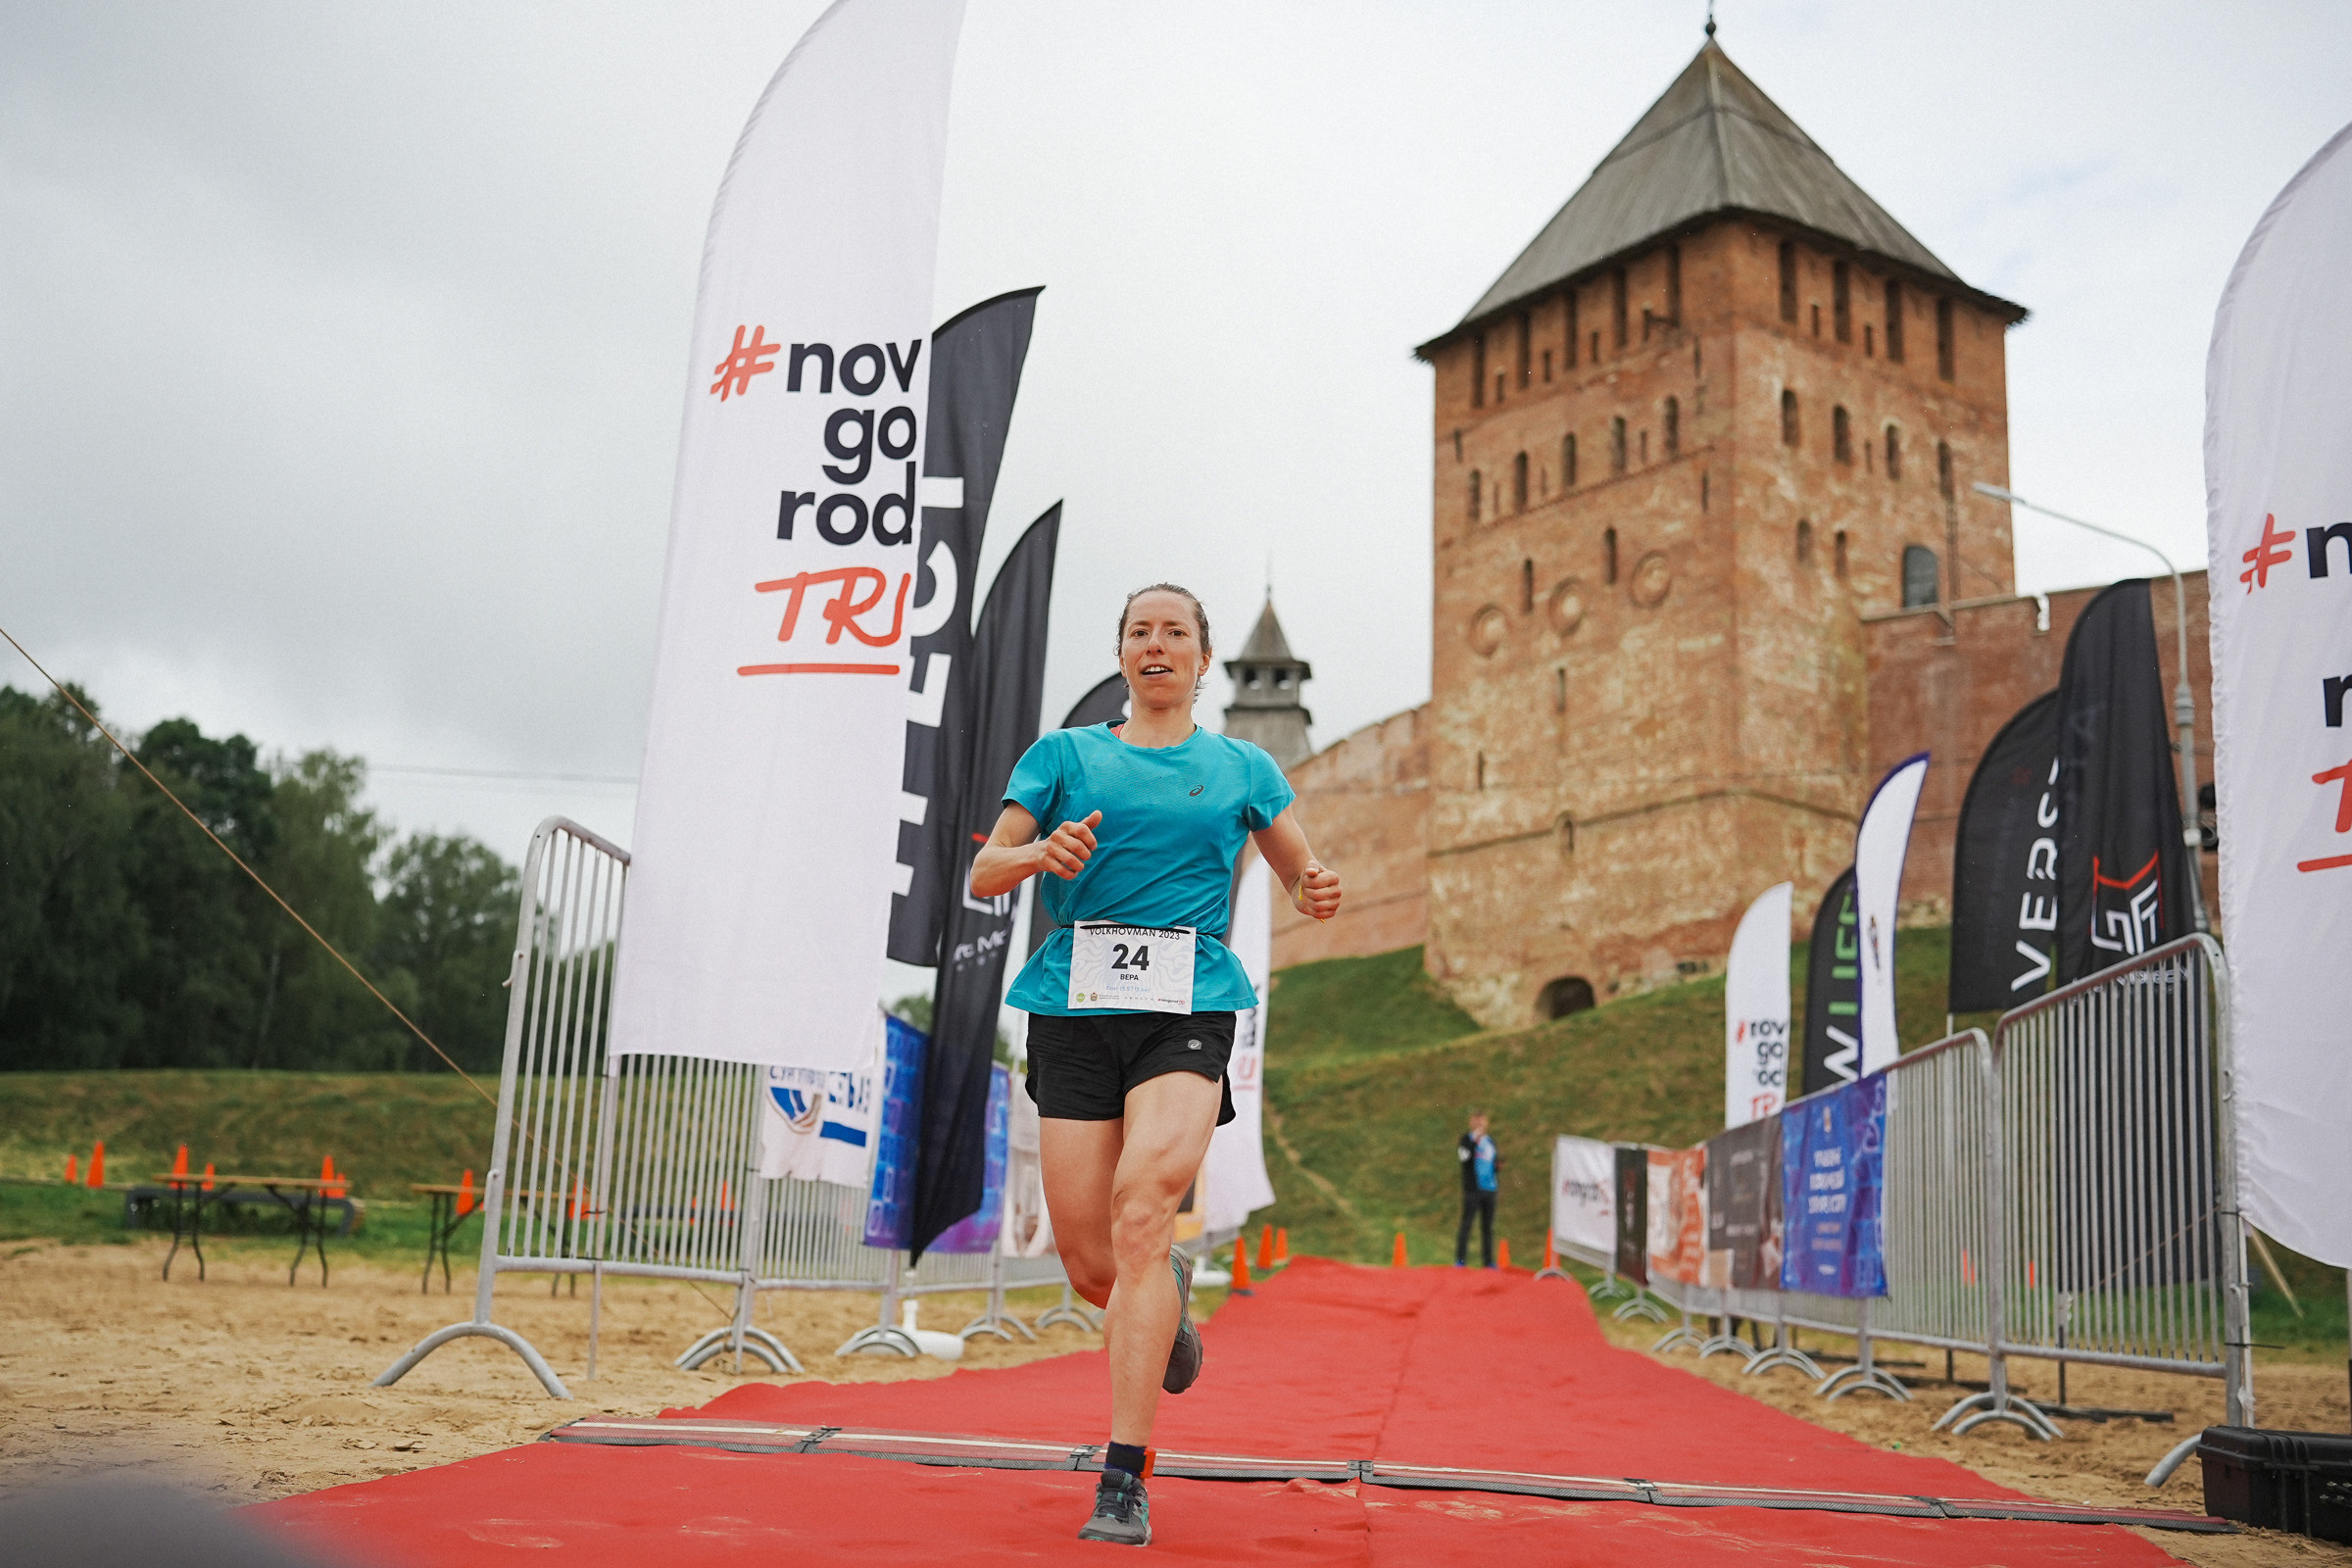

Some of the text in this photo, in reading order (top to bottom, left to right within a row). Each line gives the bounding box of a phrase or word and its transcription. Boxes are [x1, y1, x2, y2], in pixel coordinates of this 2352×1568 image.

[710, 324, 922, 402] #nov
[822, 406, 916, 484] go
[777, 462, 916, 546] rod
[755, 566, 911, 647] TRI
[1089, 927, 1180, 940] VOLKHOVMAN 2023
[1111, 944, 1150, 970] 24
